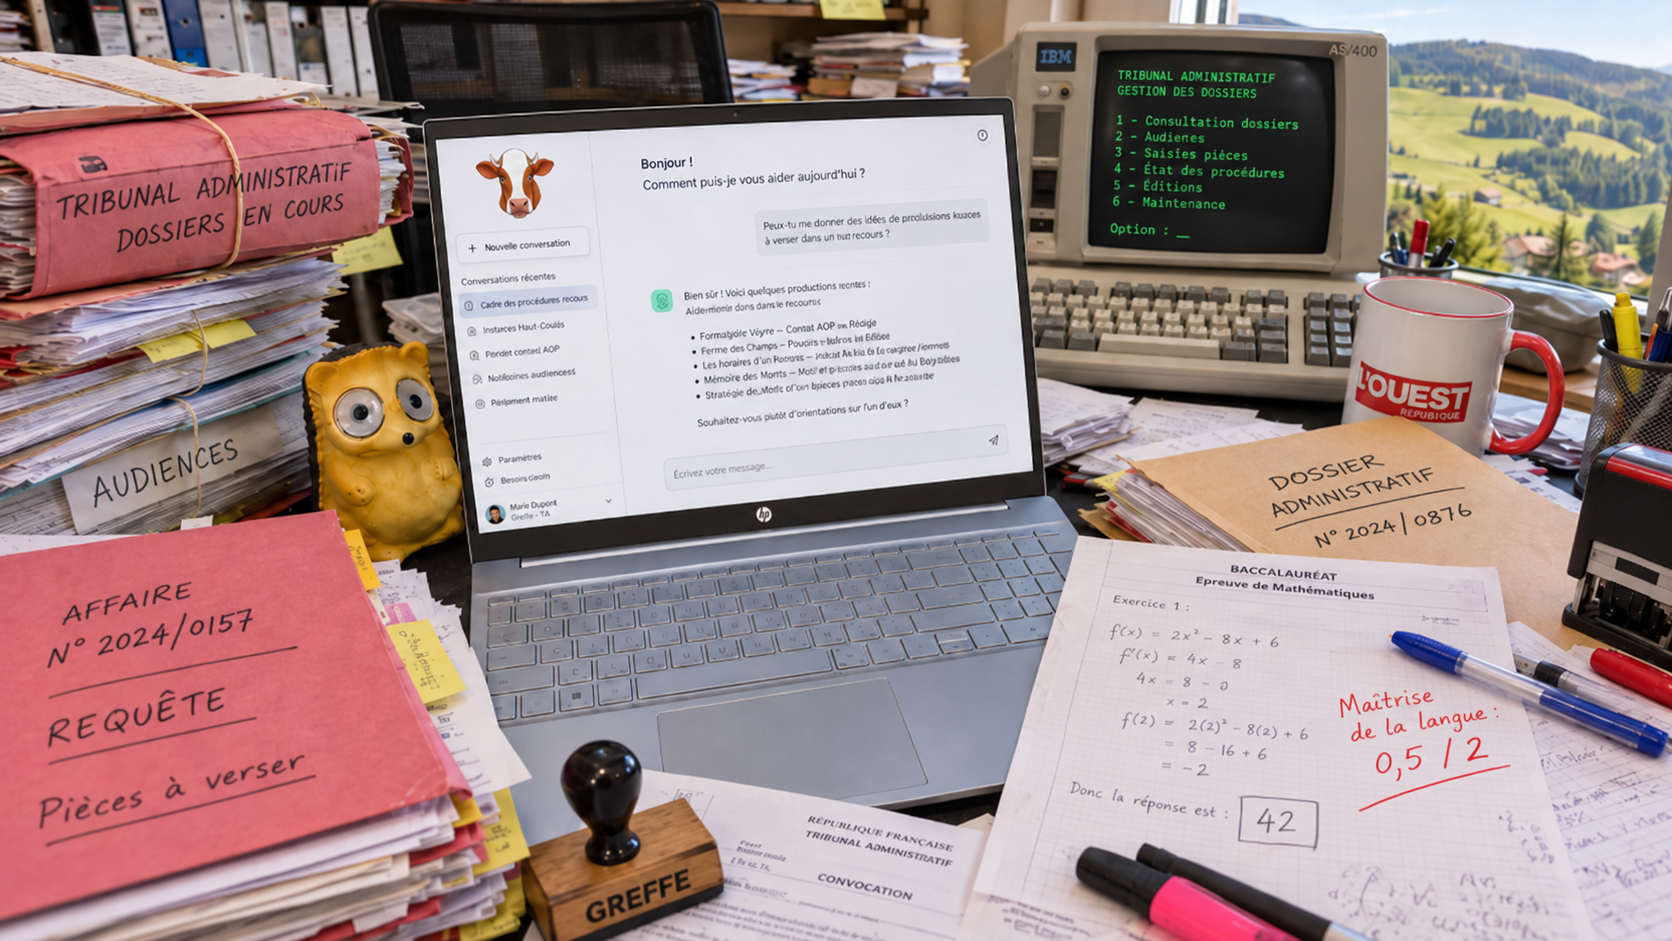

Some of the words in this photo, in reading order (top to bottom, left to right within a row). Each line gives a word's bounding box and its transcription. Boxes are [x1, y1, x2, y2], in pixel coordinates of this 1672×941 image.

[1040, 50, 1072, 64] IBM
[1329, 44, 1377, 57] AS/400
[1118, 70, 1174, 82] TRIBUNAL
[1181, 72, 1275, 84] ADMINISTRATIF
[1118, 85, 1166, 97] GESTION
[1173, 87, 1194, 97] DES
[1201, 87, 1257, 99] DOSSIERS
[1117, 115, 1122, 125] 1
[1145, 115, 1234, 128] Consultation
[1241, 117, 1299, 130] dossiers
[1116, 131, 1122, 141] 2
[1145, 132, 1205, 144] Audienes
[1115, 147, 1122, 157] 3
[1144, 148, 1196, 160] Saisies
[1204, 148, 1248, 163] pièces
[641, 158, 686, 172] Bonjour
[1114, 163, 1121, 173] 4
[1144, 162, 1173, 175] État
[1181, 165, 1203, 176] des
[1211, 164, 1285, 180] procédures
[643, 178, 697, 191] Comment
[700, 175, 736, 189] puis-je
[739, 174, 764, 184] vous
[768, 172, 794, 183] aider
[798, 168, 857, 185] aujourd'hui
[1114, 180, 1120, 190] 5
[1144, 179, 1202, 193] Éditions
[56, 181, 181, 219] TRIBUNAL
[1113, 196, 1119, 206] 6
[1143, 197, 1225, 209] Maintenance
[116, 213, 224, 253] DOSSIERS
[244, 203, 271, 227] EN
[284, 193, 344, 220] COURS
[764, 221, 796, 230] Peux-tu
[799, 220, 812, 228] me
[814, 218, 844, 227] donner
[847, 217, 862, 226] des
[889, 215, 899, 223] de
[1110, 223, 1155, 238] Option
[485, 243, 517, 251] Nouvelle
[520, 239, 570, 249] conversation
[765, 235, 770, 245] à
[772, 235, 798, 245] verser
[801, 234, 821, 243] dans
[824, 233, 834, 241] un
[853, 230, 883, 240] recours
[461, 275, 518, 286] Conversations
[521, 273, 556, 282] récentes
[684, 292, 703, 300] Bien
[705, 289, 718, 299] sûr
[725, 287, 745, 298] Voici
[748, 287, 786, 297] quelques
[788, 282, 836, 295] productions
[481, 300, 502, 309] Cadre
[504, 299, 516, 307] des
[518, 297, 560, 308] procédures
[562, 295, 588, 303] recours
[817, 321, 835, 330] AOP
[543, 345, 560, 353] AOP
[701, 346, 728, 355] Ferme
[730, 344, 744, 352] des
[747, 342, 778, 352] Champs
[702, 361, 717, 369] Les
[704, 375, 740, 384] Mémoire
[743, 372, 757, 381] des
[705, 388, 744, 399] Stratégie
[1357, 366, 1469, 410] L'OUEST
[698, 413, 762, 428] Souhaitez-vous
[789, 405, 846, 419] d'orientations
[848, 404, 861, 413] sur
[880, 400, 901, 410] d'eux
[499, 453, 542, 464] Paramètres
[94, 438, 238, 508] AUDIENCES
[674, 467, 703, 479] Écrivez
[705, 466, 726, 476] votre
[1269, 454, 1385, 491] DOSSIER
[1271, 467, 1434, 518] ADMINISTRATIF
[510, 502, 529, 511] Marie
[531, 500, 557, 510] Dupont
[757, 507, 772, 522] hp
[1315, 530, 1337, 548] N°
[1230, 564, 1337, 581] BACCALAURÉAT
[1196, 576, 1248, 591] Epreuve
[1252, 580, 1268, 590] de
[1272, 581, 1375, 601] Mathématiques
[62, 582, 192, 625] AFFAIRE
[1113, 595, 1166, 611] Exercice
[47, 637, 85, 668] N°
[97, 608, 253, 656] 2024/0157
[1109, 624, 1142, 641] f(x)
[1270, 636, 1279, 648] 6
[1232, 657, 1242, 670] 8
[1183, 676, 1191, 688] 8
[1198, 697, 1208, 709] 2
[1339, 691, 1434, 718] Maîtrise
[48, 687, 225, 747] REQUÊTE
[1122, 711, 1156, 729] f(2)
[1299, 728, 1308, 740] 6
[1351, 722, 1376, 742] de
[1386, 718, 1407, 735] la
[1420, 709, 1487, 732] langue
[1188, 740, 1197, 753] 8
[1221, 744, 1234, 757] 16
[1257, 747, 1267, 761] 6
[1375, 745, 1422, 781] 0,5
[1466, 736, 1489, 762] 2
[39, 790, 142, 829] Pièces
[165, 776, 186, 799] à
[205, 755, 304, 790] verser
[1070, 781, 1102, 799] Donc
[1112, 788, 1124, 803] la
[1133, 795, 1187, 820] réponse
[1194, 805, 1216, 818] est
[1256, 808, 1296, 834] 42
[808, 815, 883, 837] RÉPUBLIQUE
[886, 831, 954, 852] FRANÇAISE
[805, 830, 862, 849] TRIBUNAL
[865, 843, 953, 868] ADMINISTRATIF
[818, 873, 913, 901] CONVOCATION
[586, 869, 691, 923] GREFFE
